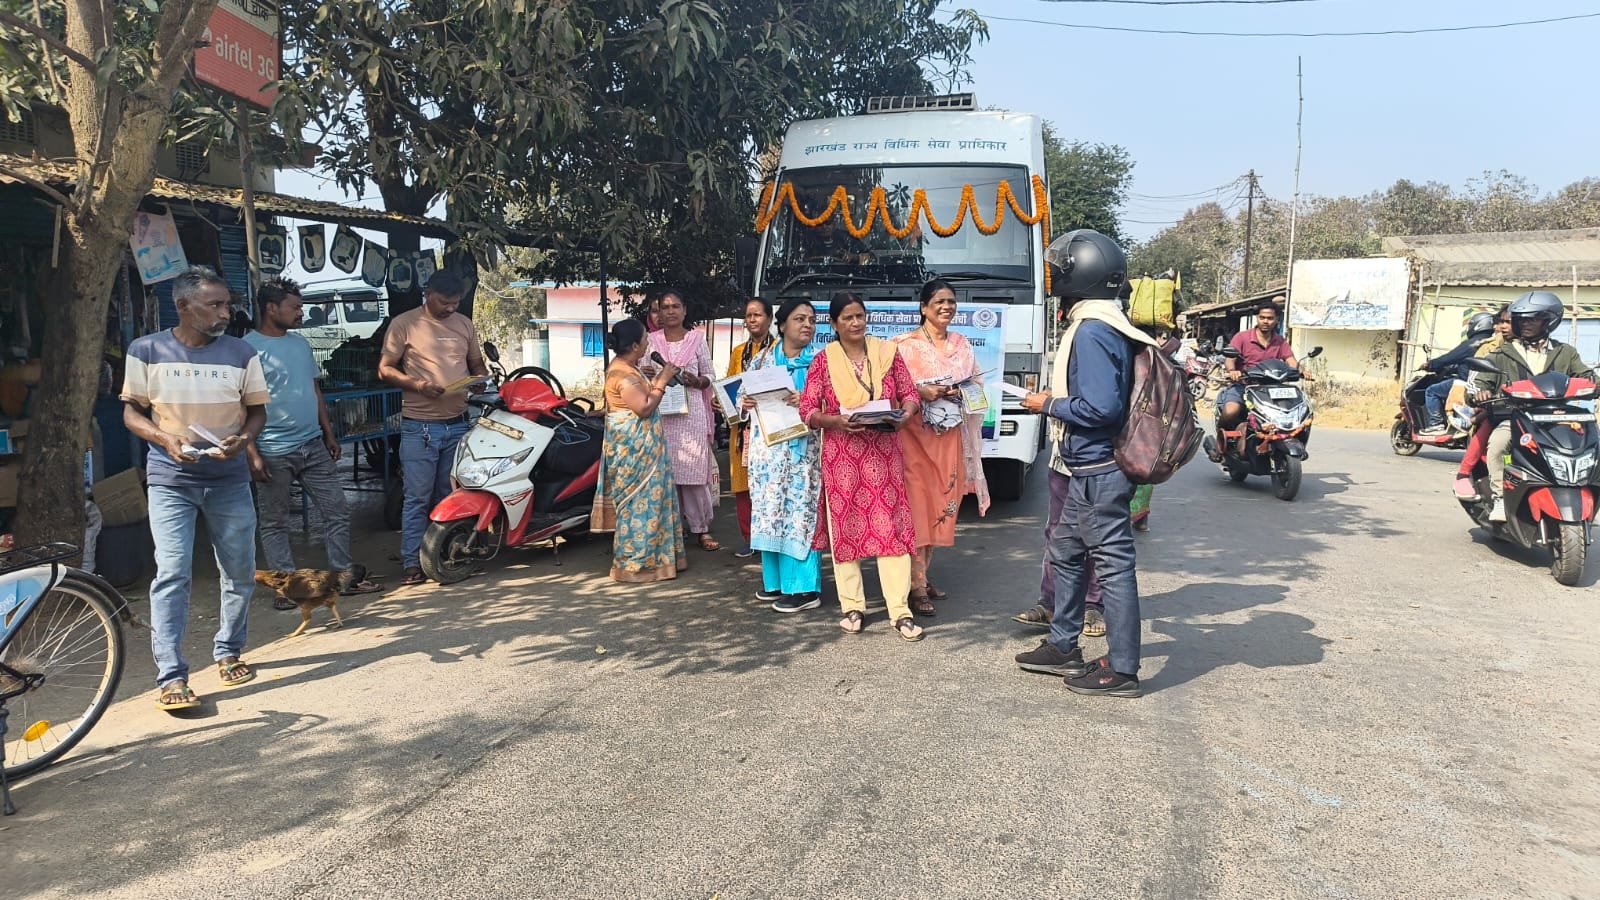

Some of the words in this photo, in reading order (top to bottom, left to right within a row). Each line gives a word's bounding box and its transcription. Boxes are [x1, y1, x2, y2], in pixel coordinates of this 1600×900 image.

[215, 34, 253, 72] airtel
[257, 55, 275, 81] 3G
[804, 141, 847, 156] झारखंड
[852, 141, 878, 150] राज्य
[884, 138, 921, 150] विधिक
[927, 137, 950, 150] सेवा
[958, 137, 1008, 151] प्राधिकार
[895, 312, 912, 323] सेवा
[166, 369, 228, 379] INSPIRE
